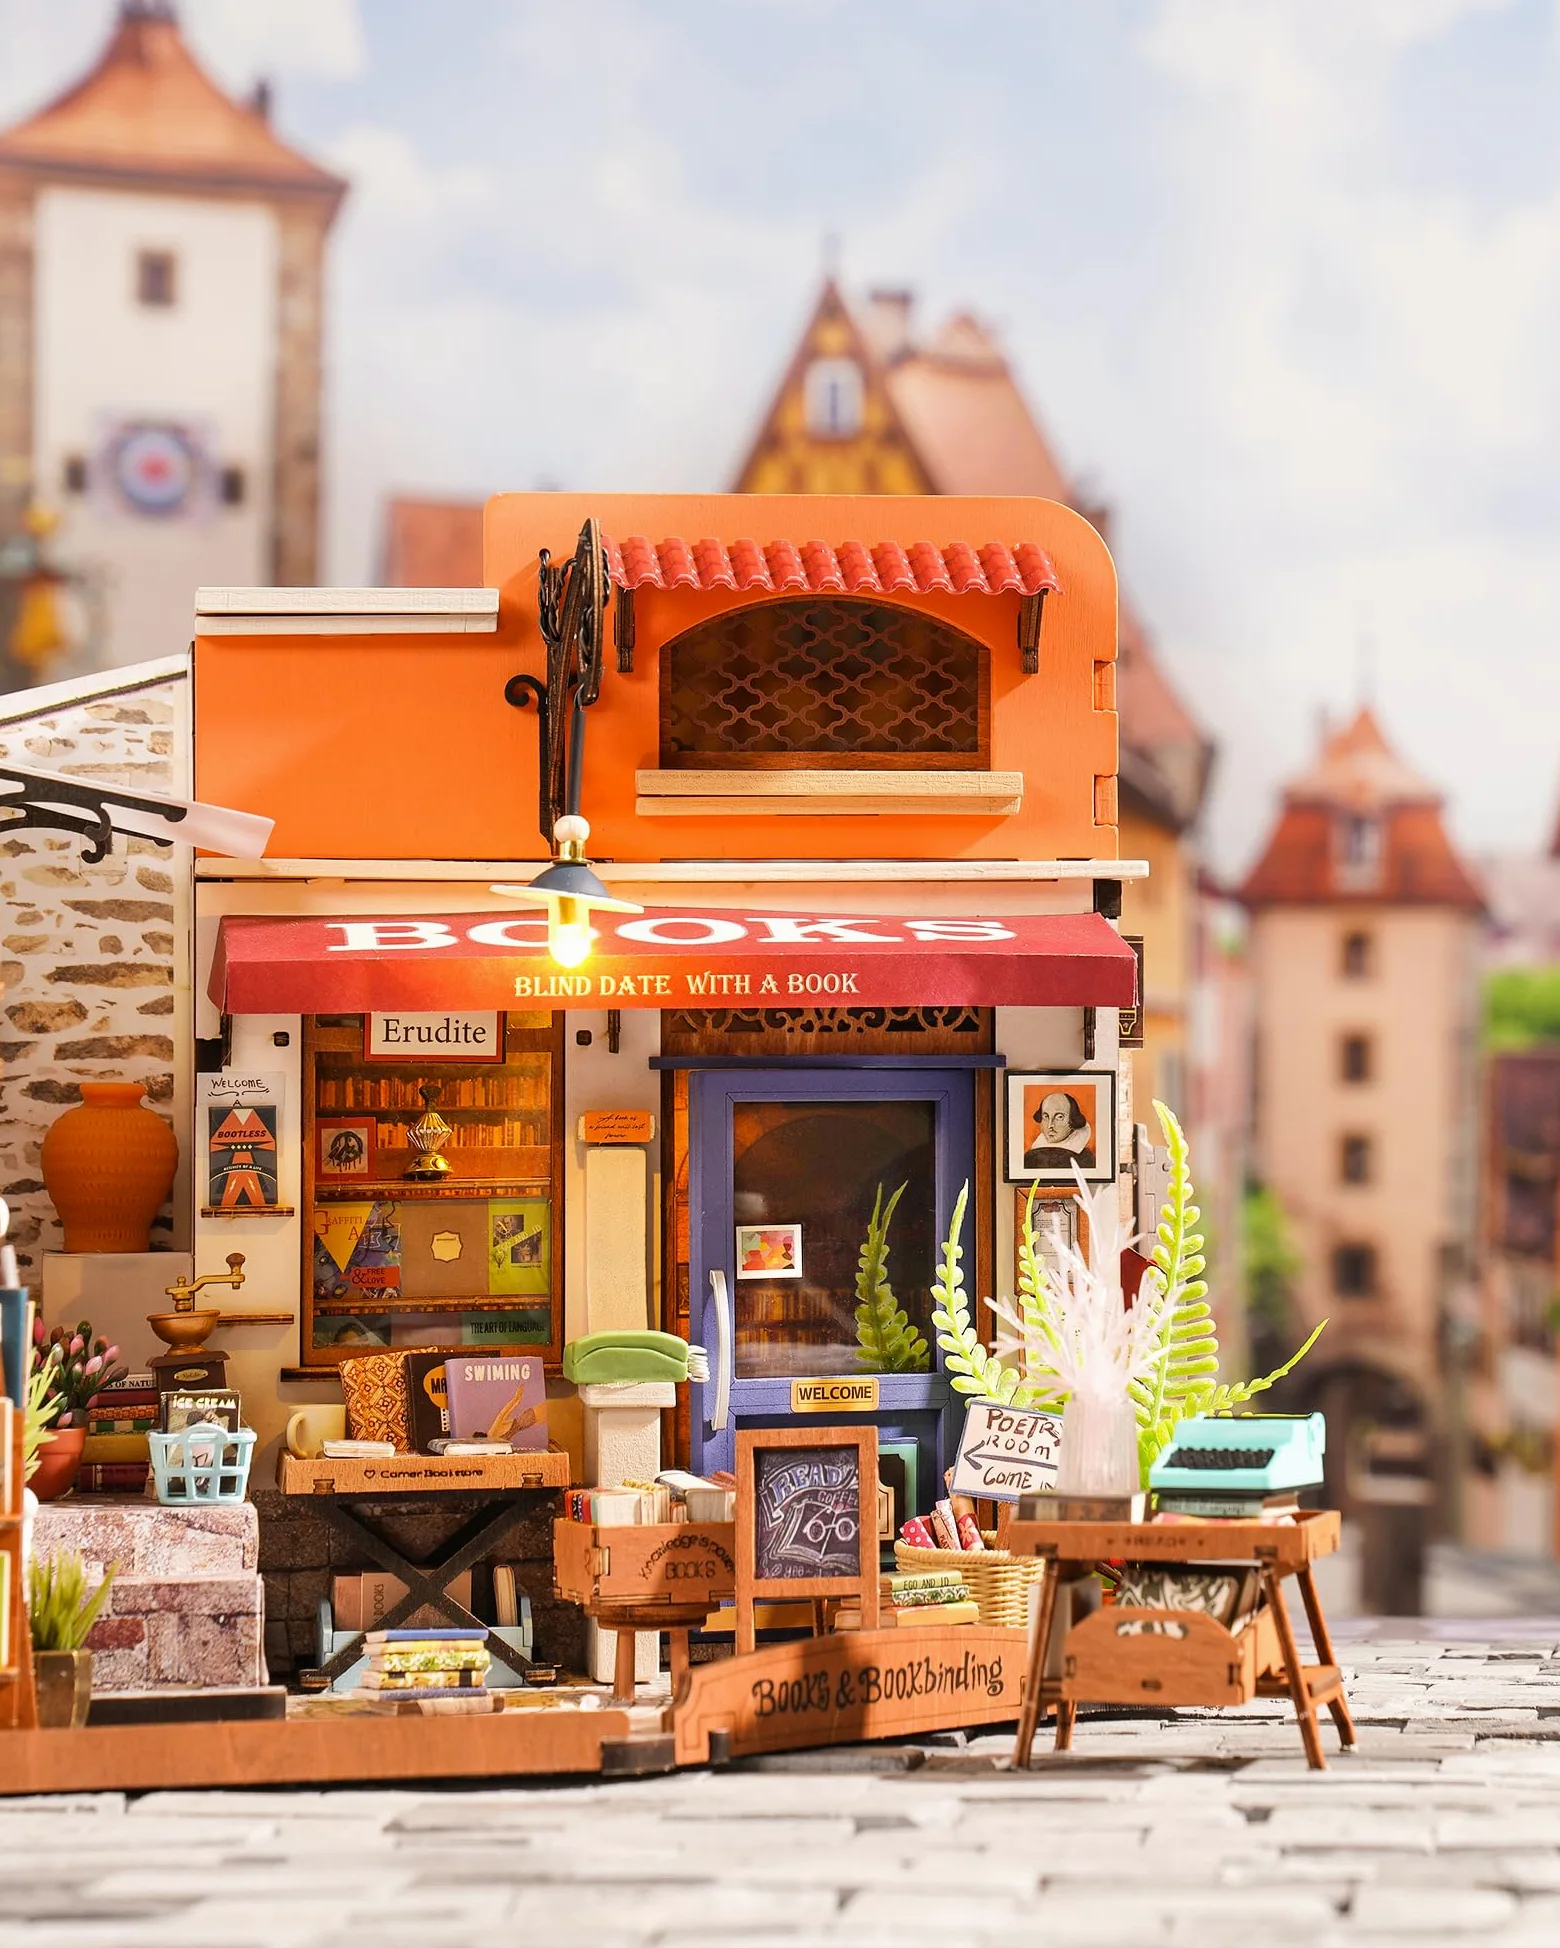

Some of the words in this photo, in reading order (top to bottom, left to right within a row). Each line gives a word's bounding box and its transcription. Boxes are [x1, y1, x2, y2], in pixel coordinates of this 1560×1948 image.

[514, 975, 592, 997] BLIND
[599, 975, 673, 996] DATE
[686, 970, 752, 995] WITH
[759, 973, 781, 995] A
[786, 972, 861, 995] BOOK
[381, 1017, 487, 1045] Erudite
[211, 1078, 266, 1089] WELCOME
[217, 1130, 267, 1139] BOOTLESS
[366, 1268, 386, 1276] FREE
[366, 1277, 386, 1285] LOVE
[470, 1321, 483, 1335] THE
[484, 1321, 498, 1334] ART
[499, 1321, 508, 1334] OF
[508, 1320, 546, 1334] LANGUAGE
[465, 1364, 531, 1382] SWIMING
[115, 1380, 127, 1388] OF
[798, 1385, 873, 1401] WELCOME
[195, 1397, 237, 1410] CREAM
[769, 1463, 842, 1507] READ
[665, 1560, 716, 1580] BOOKS
[903, 1580, 918, 1590] EGO
[922, 1578, 936, 1589] AND
[834, 1669, 858, 1709] &
